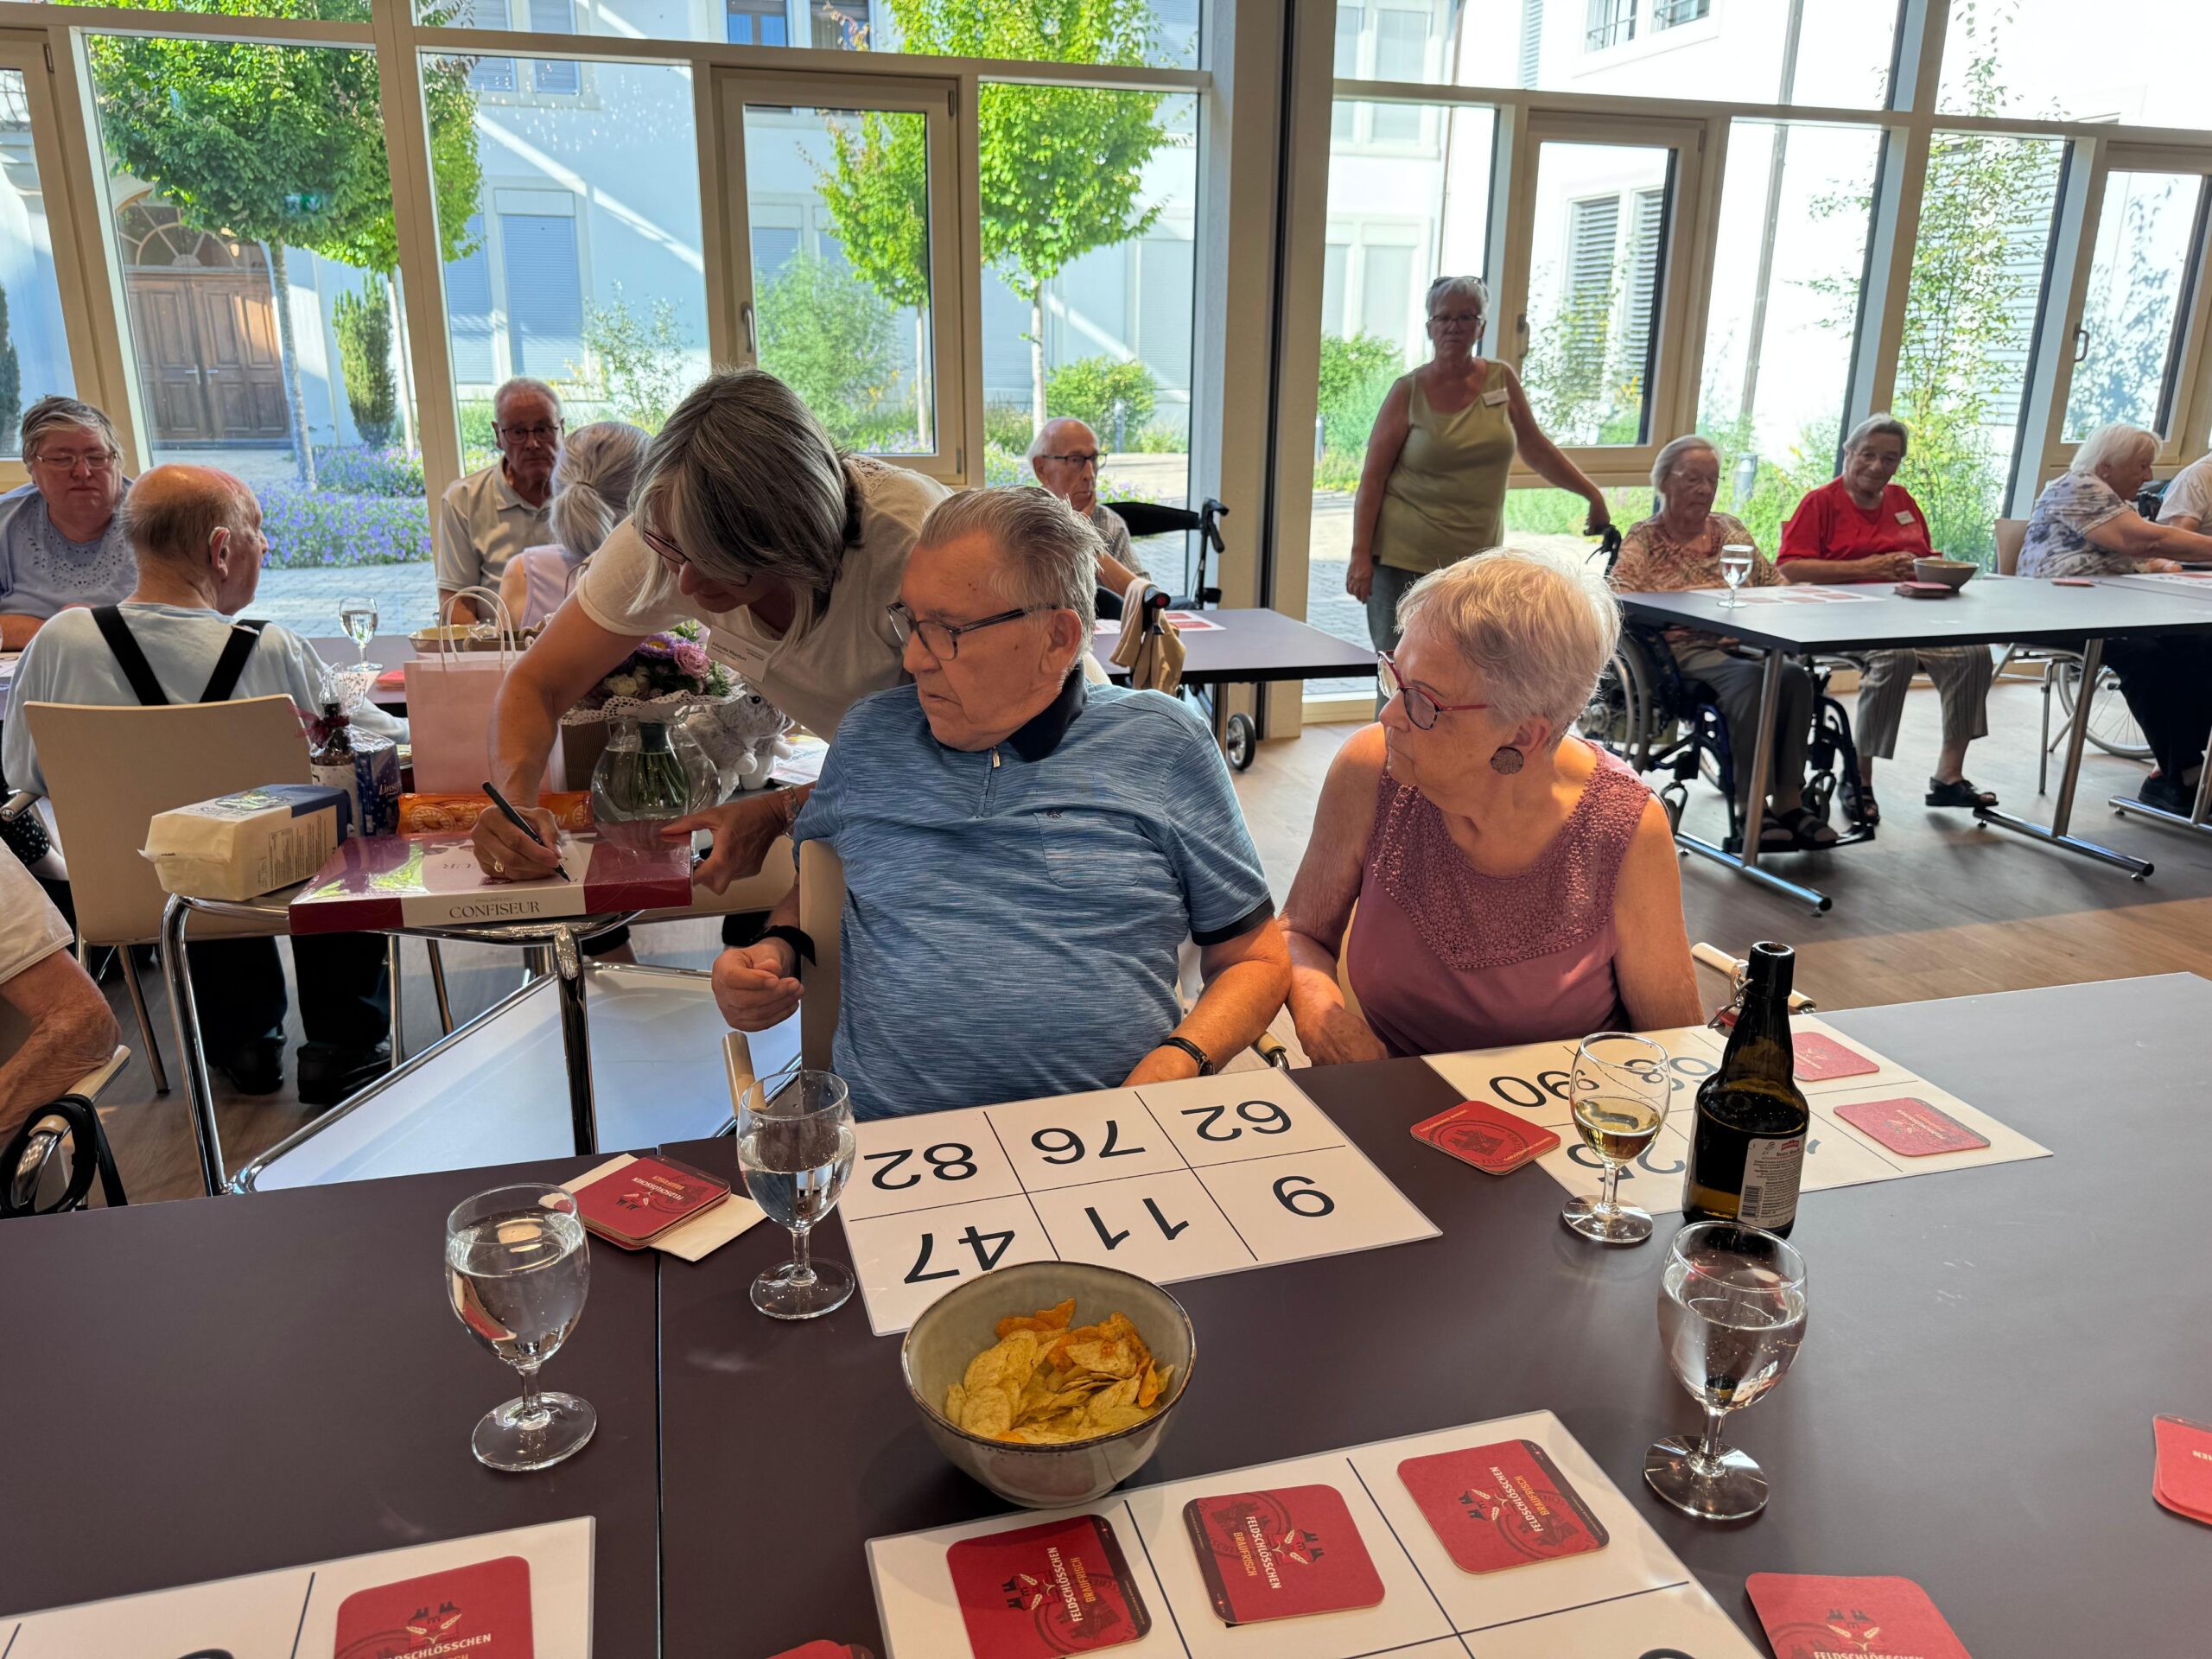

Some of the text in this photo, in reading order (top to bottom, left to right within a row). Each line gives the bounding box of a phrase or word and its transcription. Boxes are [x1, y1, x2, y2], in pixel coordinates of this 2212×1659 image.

[449, 901, 540, 919] CONFISEUR
[1031, 1120, 1146, 1165] 76
[1181, 1099, 1293, 1143] 62
[864, 1141, 978, 1191] 82
[1084, 1197, 1190, 1250] 11
[903, 1225, 1015, 1285] 47
[1489, 1466, 1543, 1532] FELDSCHLÖSSCHEN
[1514, 1475, 1550, 1516] BRAUFRISCH
[1233, 1531, 1258, 1577] BRAUFRISCH
[1246, 1516, 1281, 1589] FELDSCHLÖSSCHEN
[1046, 1547, 1084, 1623] FELDSCHLÖSSCHEN
[1071, 1557, 1096, 1603] BRAUFRISCH
[386, 1633, 492, 1659] DSCHLÖSSCHEN
